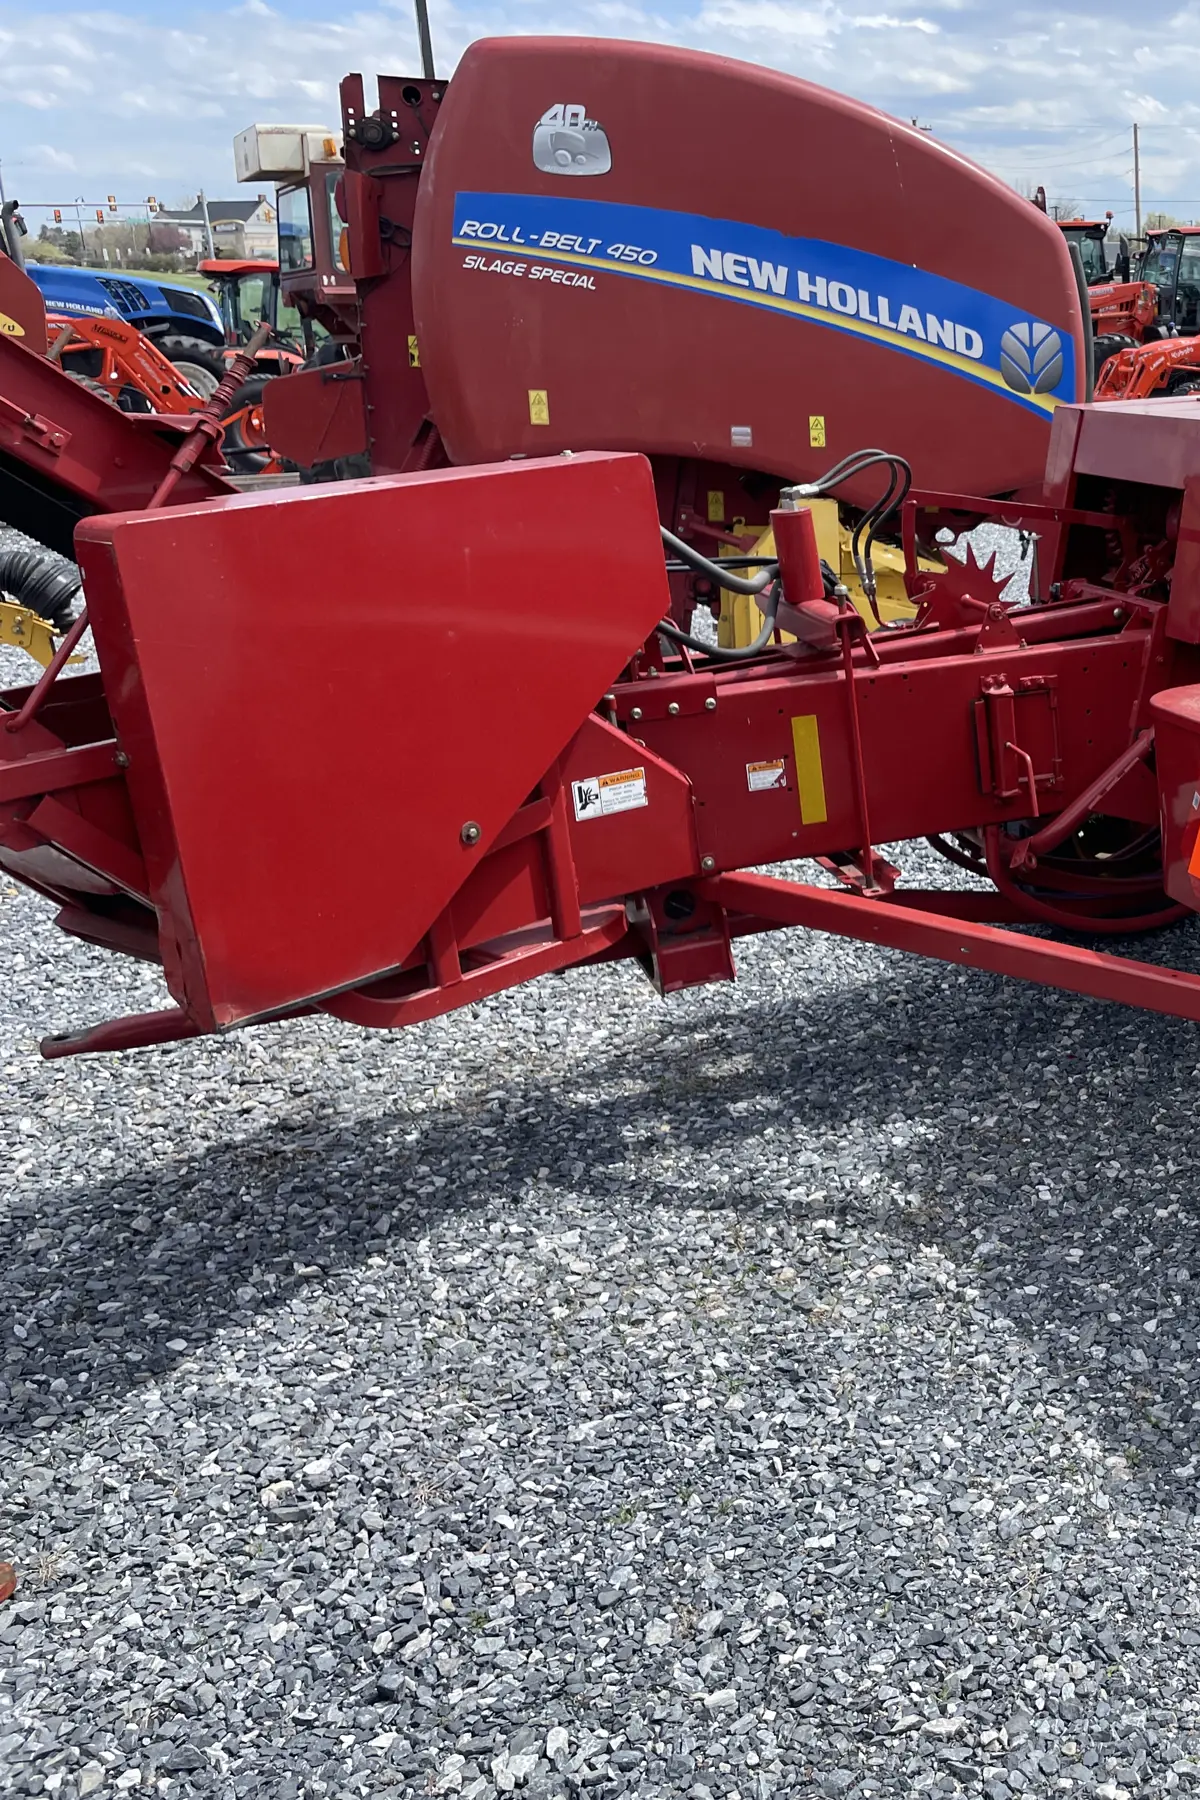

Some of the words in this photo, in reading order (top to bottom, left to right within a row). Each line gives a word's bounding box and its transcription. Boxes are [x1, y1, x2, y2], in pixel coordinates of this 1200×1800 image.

[606, 243, 658, 266] 450
[462, 255, 527, 276] SILAGE
[528, 266, 597, 290] SPECIAL
[45, 300, 66, 309] NEW
[66, 302, 103, 314] HOLLAND
[690, 244, 789, 295] NEW
[797, 270, 985, 360] HOLLAND
[609, 772, 640, 783] WARNING
